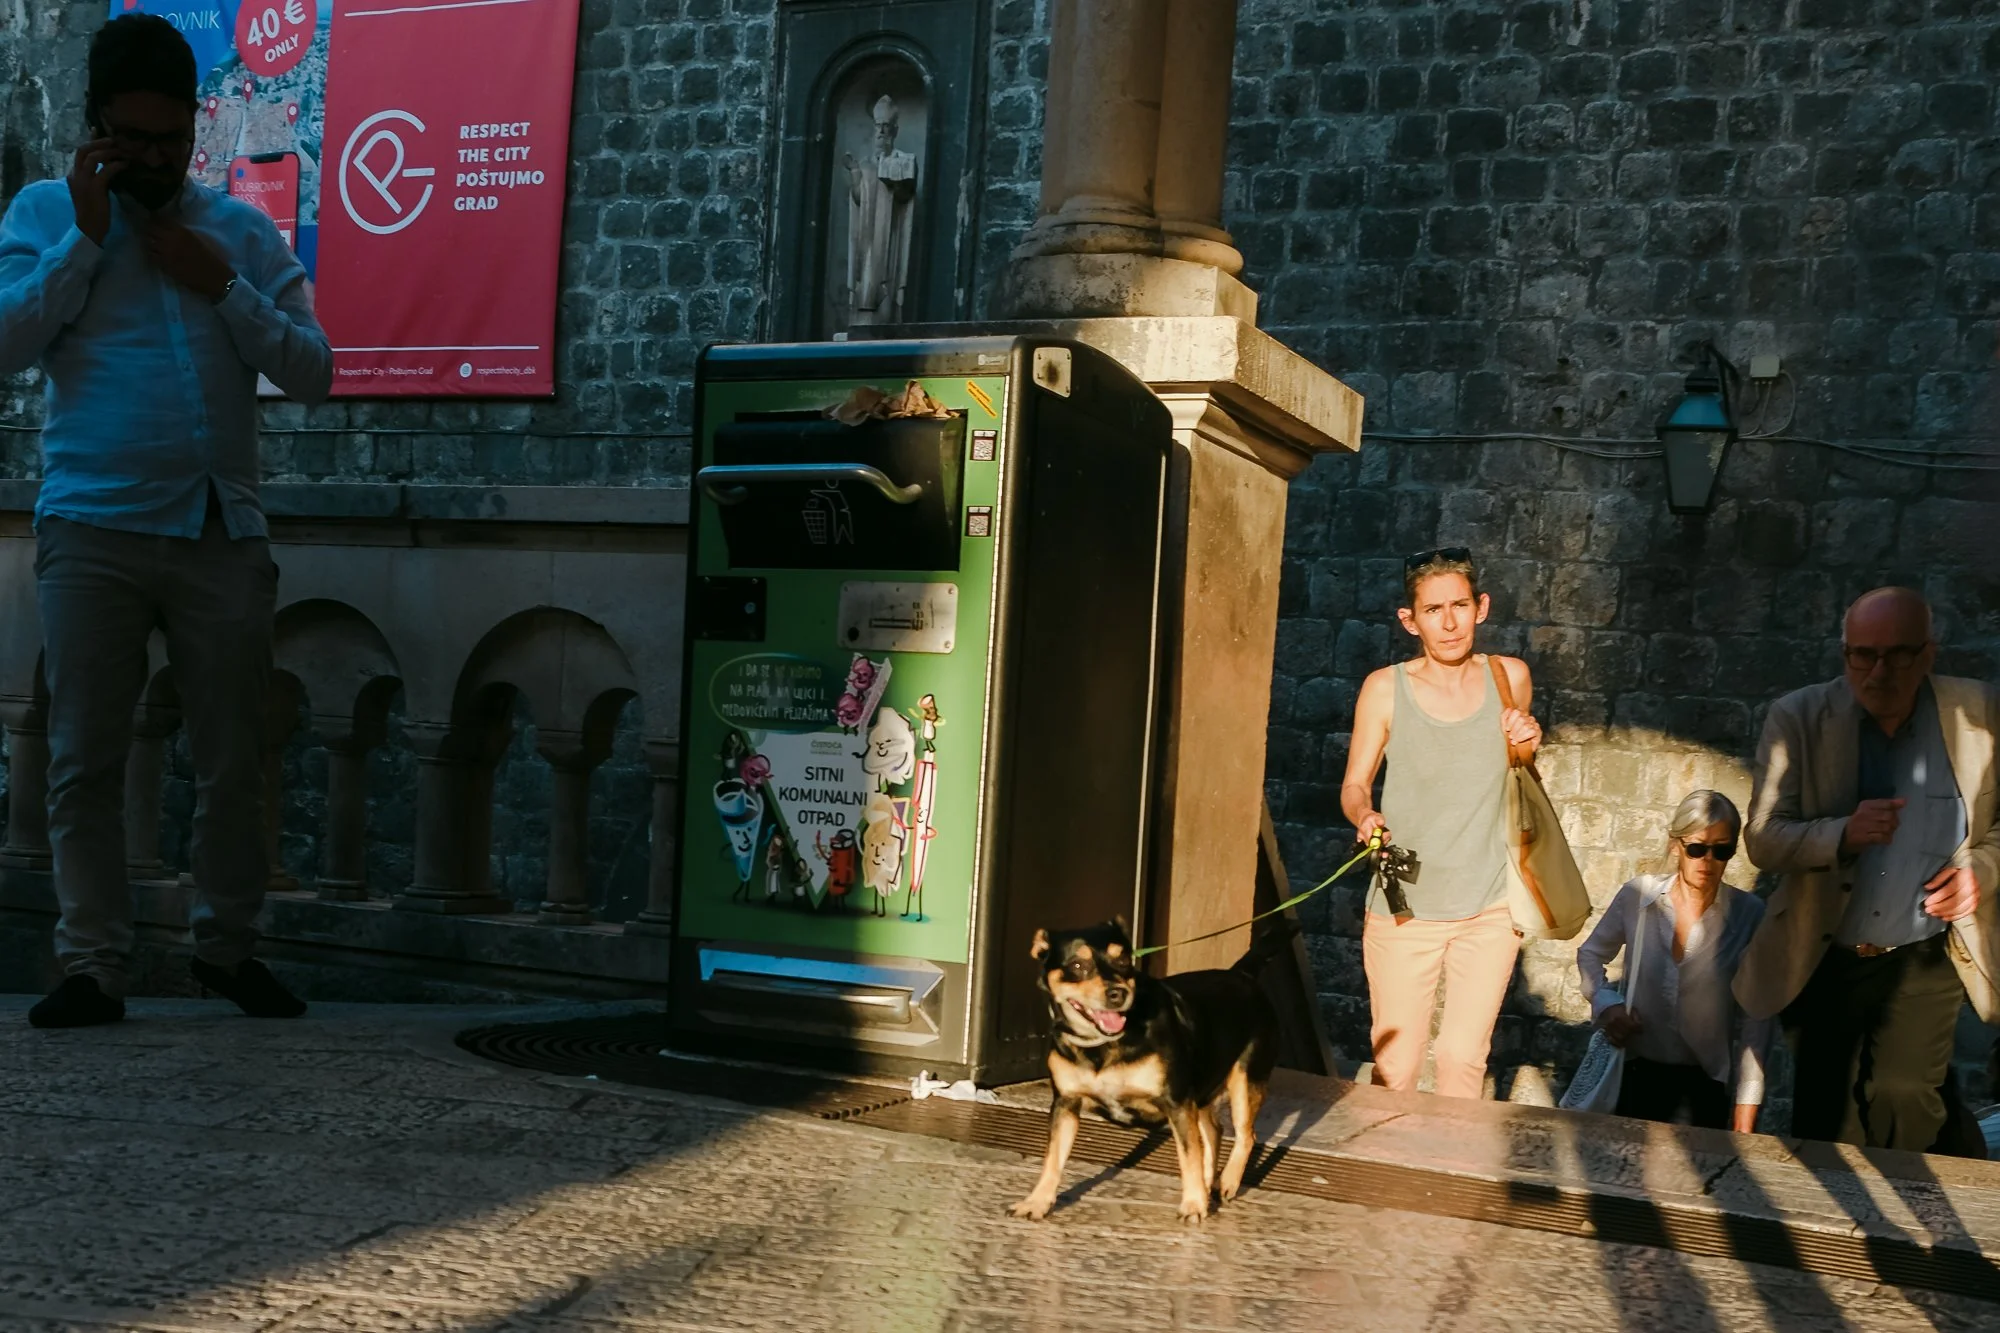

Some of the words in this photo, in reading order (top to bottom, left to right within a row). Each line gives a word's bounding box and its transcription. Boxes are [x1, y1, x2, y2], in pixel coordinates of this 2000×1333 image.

[157, 10, 220, 31] OVNIK
[247, 8, 280, 46] 40
[283, 0, 306, 24] €
[265, 33, 298, 62] ONLY
[460, 122, 531, 139] RESPECT
[458, 148, 490, 163] THE
[493, 146, 531, 162] CITY
[234, 180, 286, 192] DUBROVNIK
[456, 168, 545, 189] POŠTUJMO
[454, 196, 499, 211] GRAD
[339, 366, 361, 377] Respect
[362, 366, 372, 375] the
[373, 367, 384, 377] City
[418, 366, 433, 375] Grad
[745, 663, 757, 677] DA
[729, 683, 743, 697] NA
[804, 766, 844, 782] SITNI
[779, 787, 867, 806] KOMUNALNI
[798, 810, 845, 826] OTPAD
